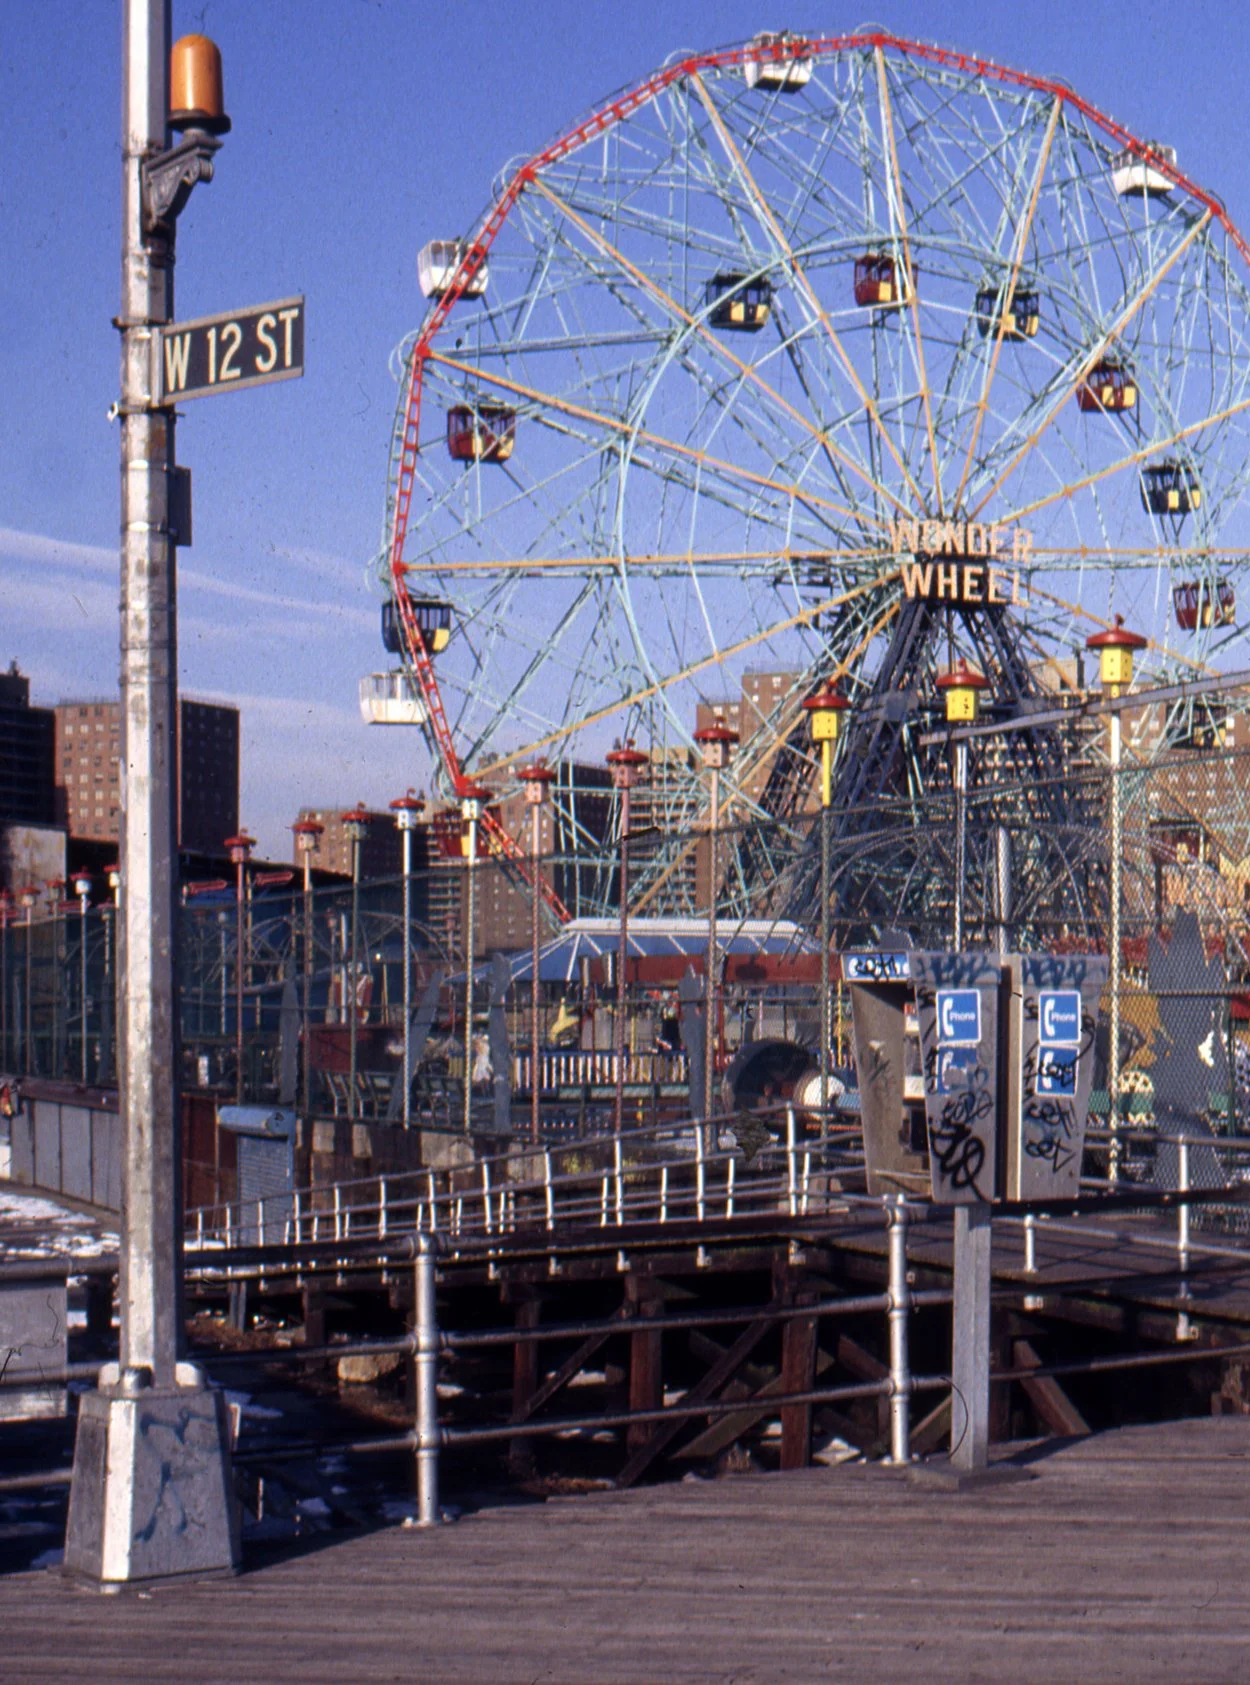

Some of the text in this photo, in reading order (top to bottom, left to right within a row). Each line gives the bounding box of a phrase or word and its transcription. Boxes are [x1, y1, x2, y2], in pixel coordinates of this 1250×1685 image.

[165, 307, 300, 393] W 12 ST
[887, 517, 1034, 564] WONDER
[899, 561, 1031, 608] WHEEL
[949, 1010, 976, 1022] Phone
[1051, 1010, 1077, 1022] Phone
